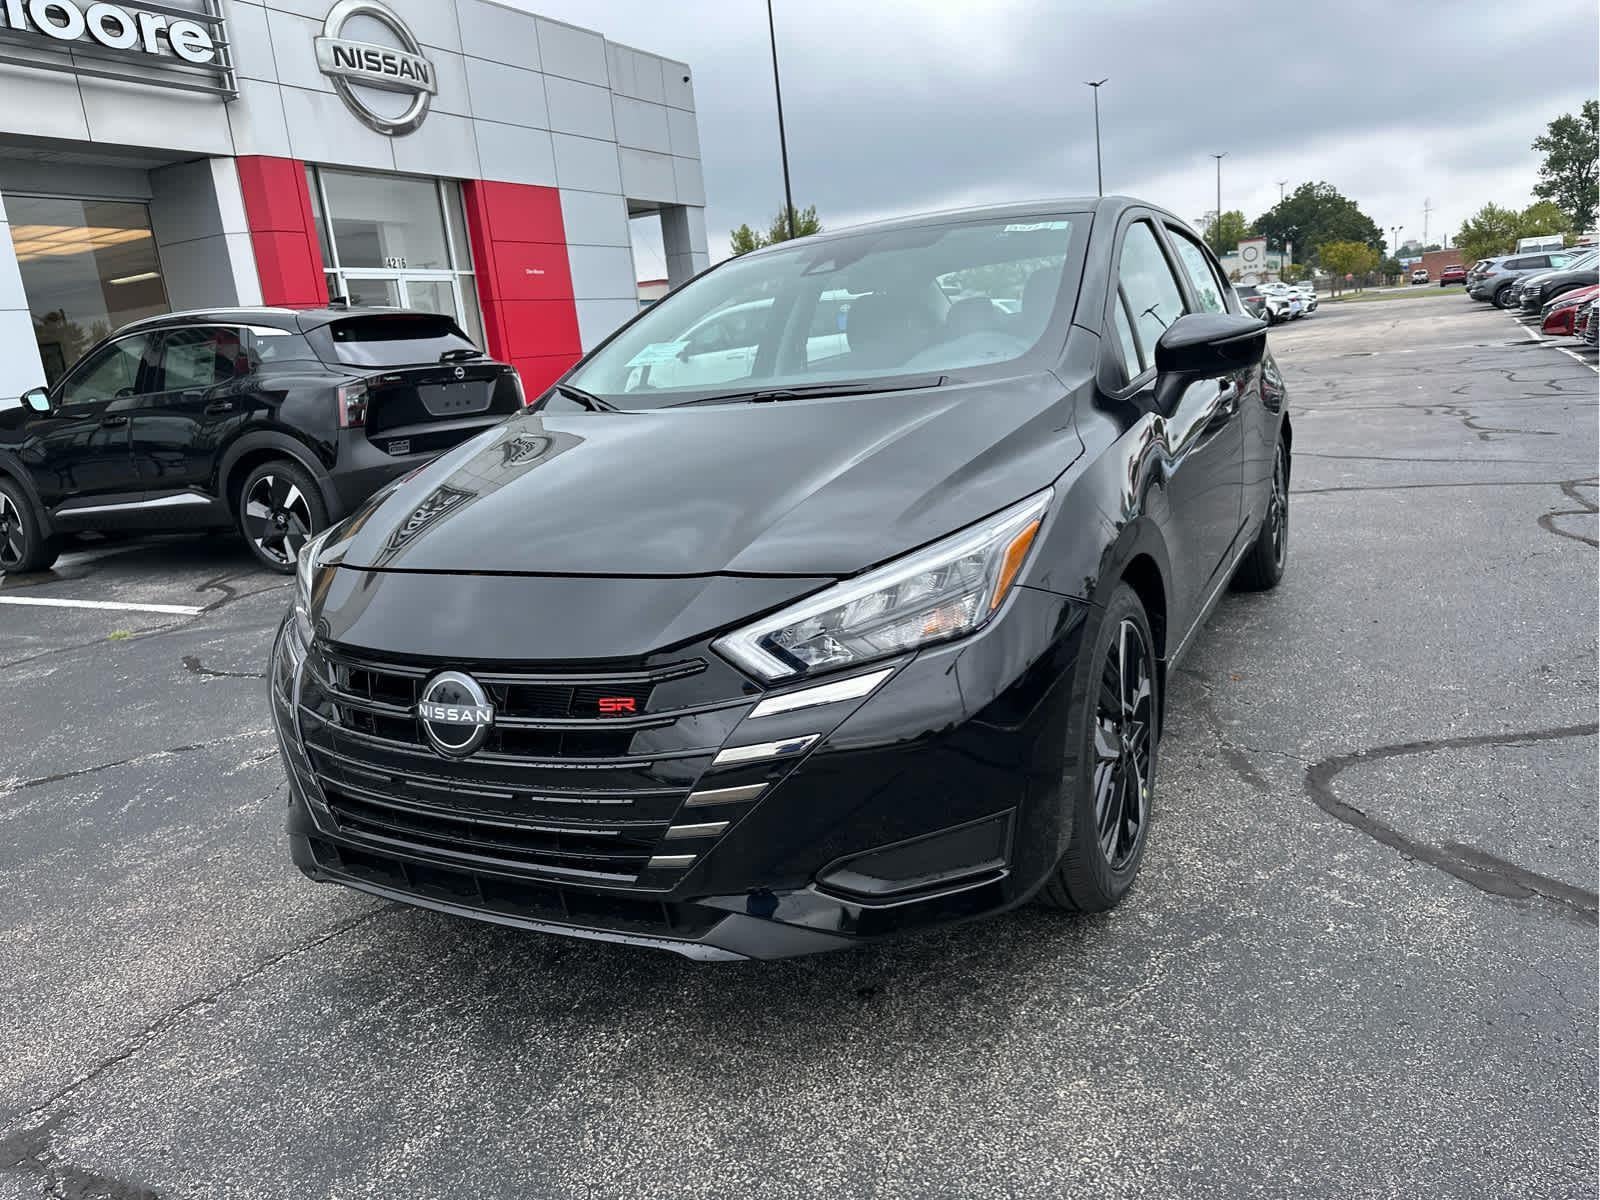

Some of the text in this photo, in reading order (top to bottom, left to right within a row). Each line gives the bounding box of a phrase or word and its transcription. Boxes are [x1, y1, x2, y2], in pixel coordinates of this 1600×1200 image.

[332, 45, 429, 84] NISSAN
[419, 703, 491, 722] NISSAN
[598, 697, 636, 711] SR
